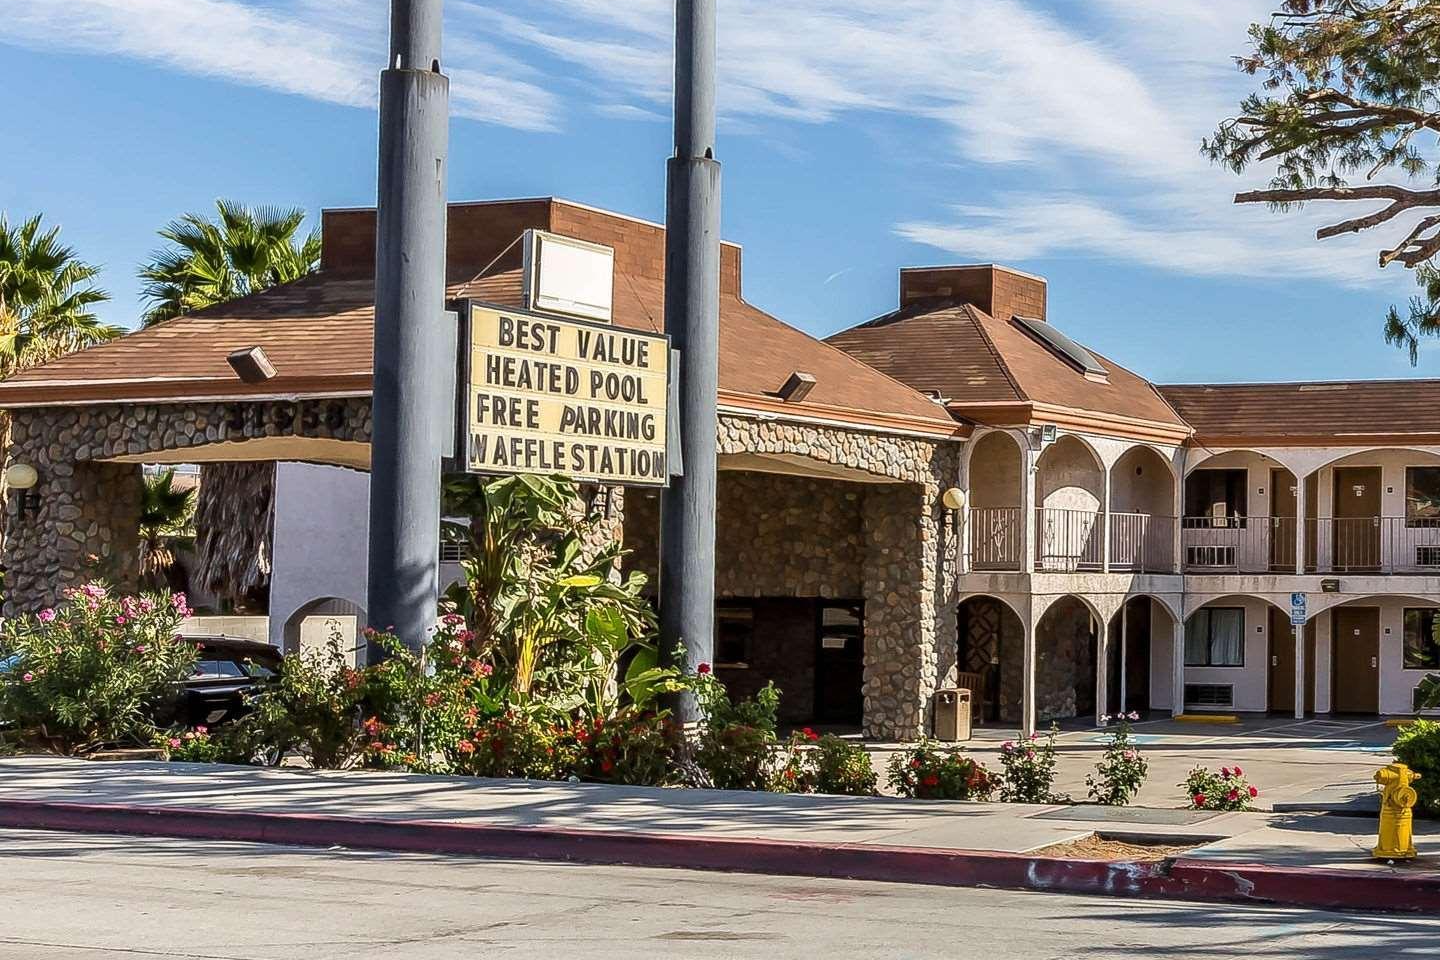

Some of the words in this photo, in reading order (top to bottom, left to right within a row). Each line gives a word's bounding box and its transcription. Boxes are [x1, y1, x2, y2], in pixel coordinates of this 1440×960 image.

[498, 316, 561, 355] BEST
[577, 329, 649, 369] VALUE
[486, 353, 580, 396] HEATED
[590, 369, 649, 405] POOL
[476, 393, 540, 430] FREE
[559, 405, 656, 442] PARKING
[470, 433, 566, 470] WAFFLE
[571, 443, 665, 478] STATION
